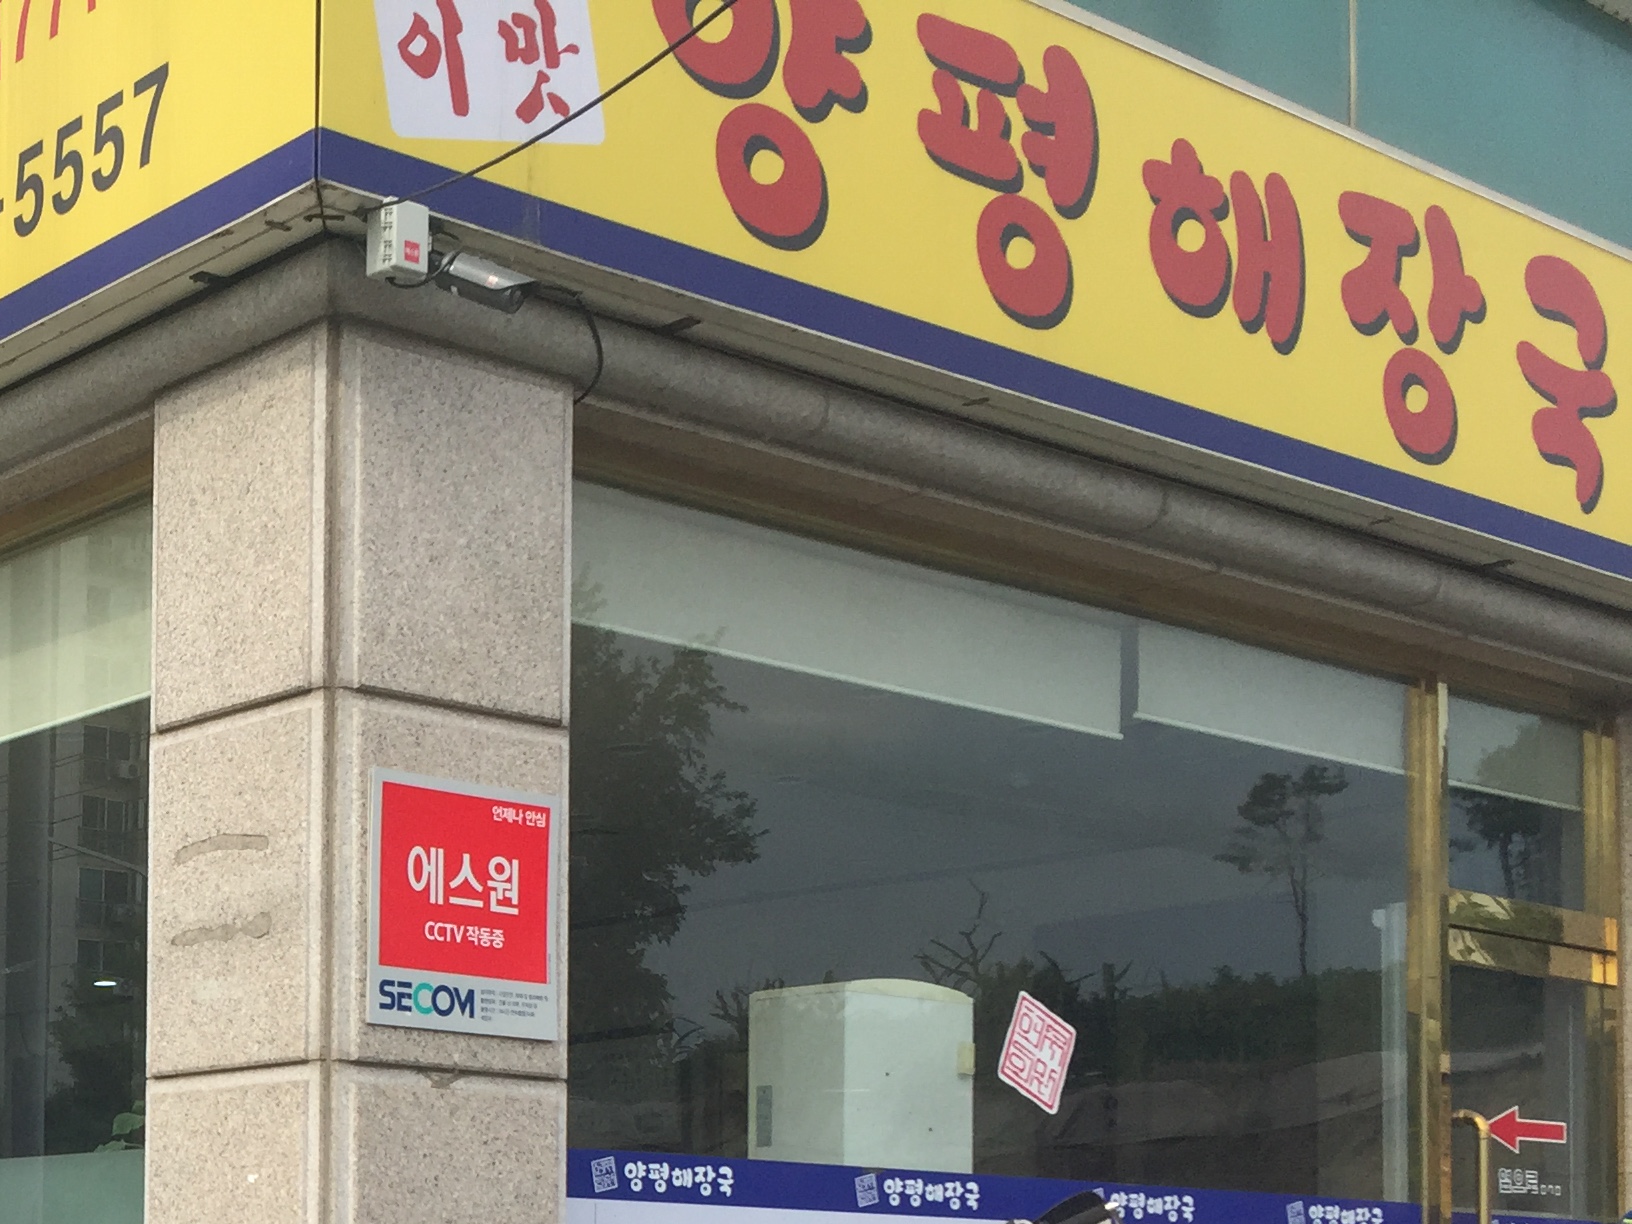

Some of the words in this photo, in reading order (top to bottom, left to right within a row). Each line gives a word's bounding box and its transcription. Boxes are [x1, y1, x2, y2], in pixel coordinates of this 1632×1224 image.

[652, 0, 1618, 515] 양평해장국
[492, 804, 524, 826] 언제나
[525, 809, 547, 828] 안심
[407, 845, 519, 916] 에스원
[424, 920, 465, 944] CCTV
[466, 925, 506, 949] 작동중
[378, 979, 476, 1019] SECOM
[624, 1160, 735, 1198] 양평해장국
[883, 1177, 981, 1211] 양평해장국
[1110, 1190, 1196, 1223] 양평해장국
